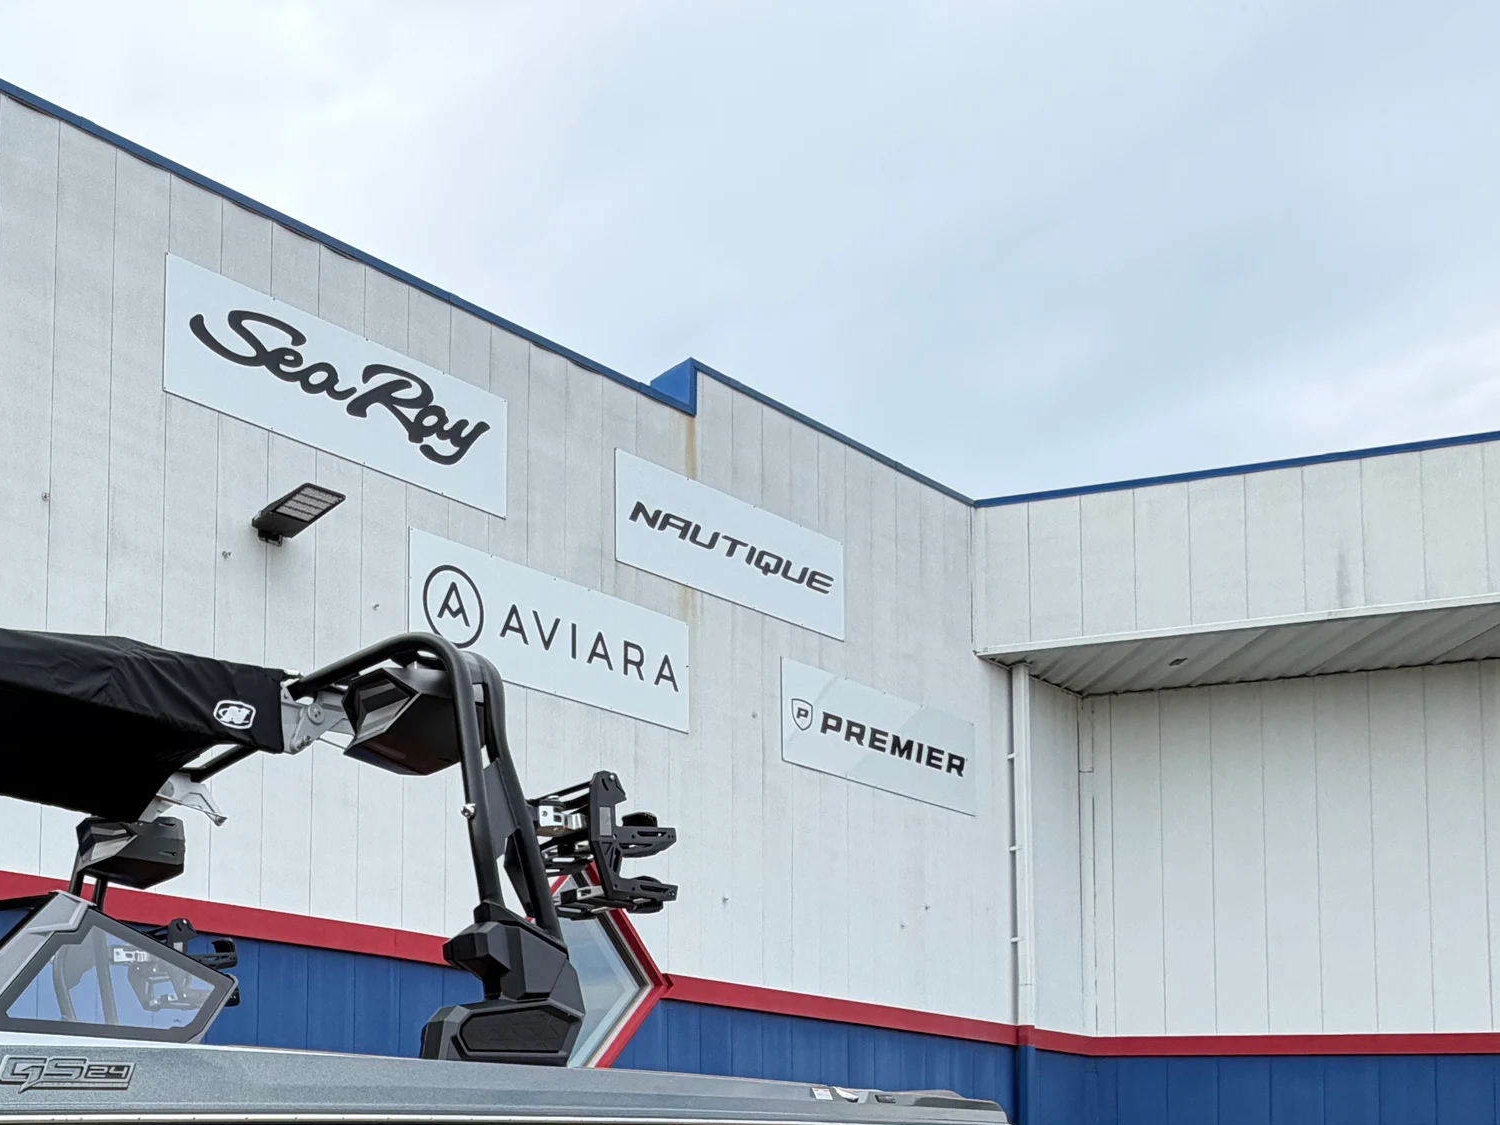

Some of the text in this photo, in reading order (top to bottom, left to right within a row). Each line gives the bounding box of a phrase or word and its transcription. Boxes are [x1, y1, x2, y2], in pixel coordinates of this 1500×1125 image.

[189, 310, 491, 466] Sea Ray
[628, 500, 835, 595] NAUTIQUE
[499, 603, 679, 693] AVIARA
[819, 711, 966, 778] PREMIER
